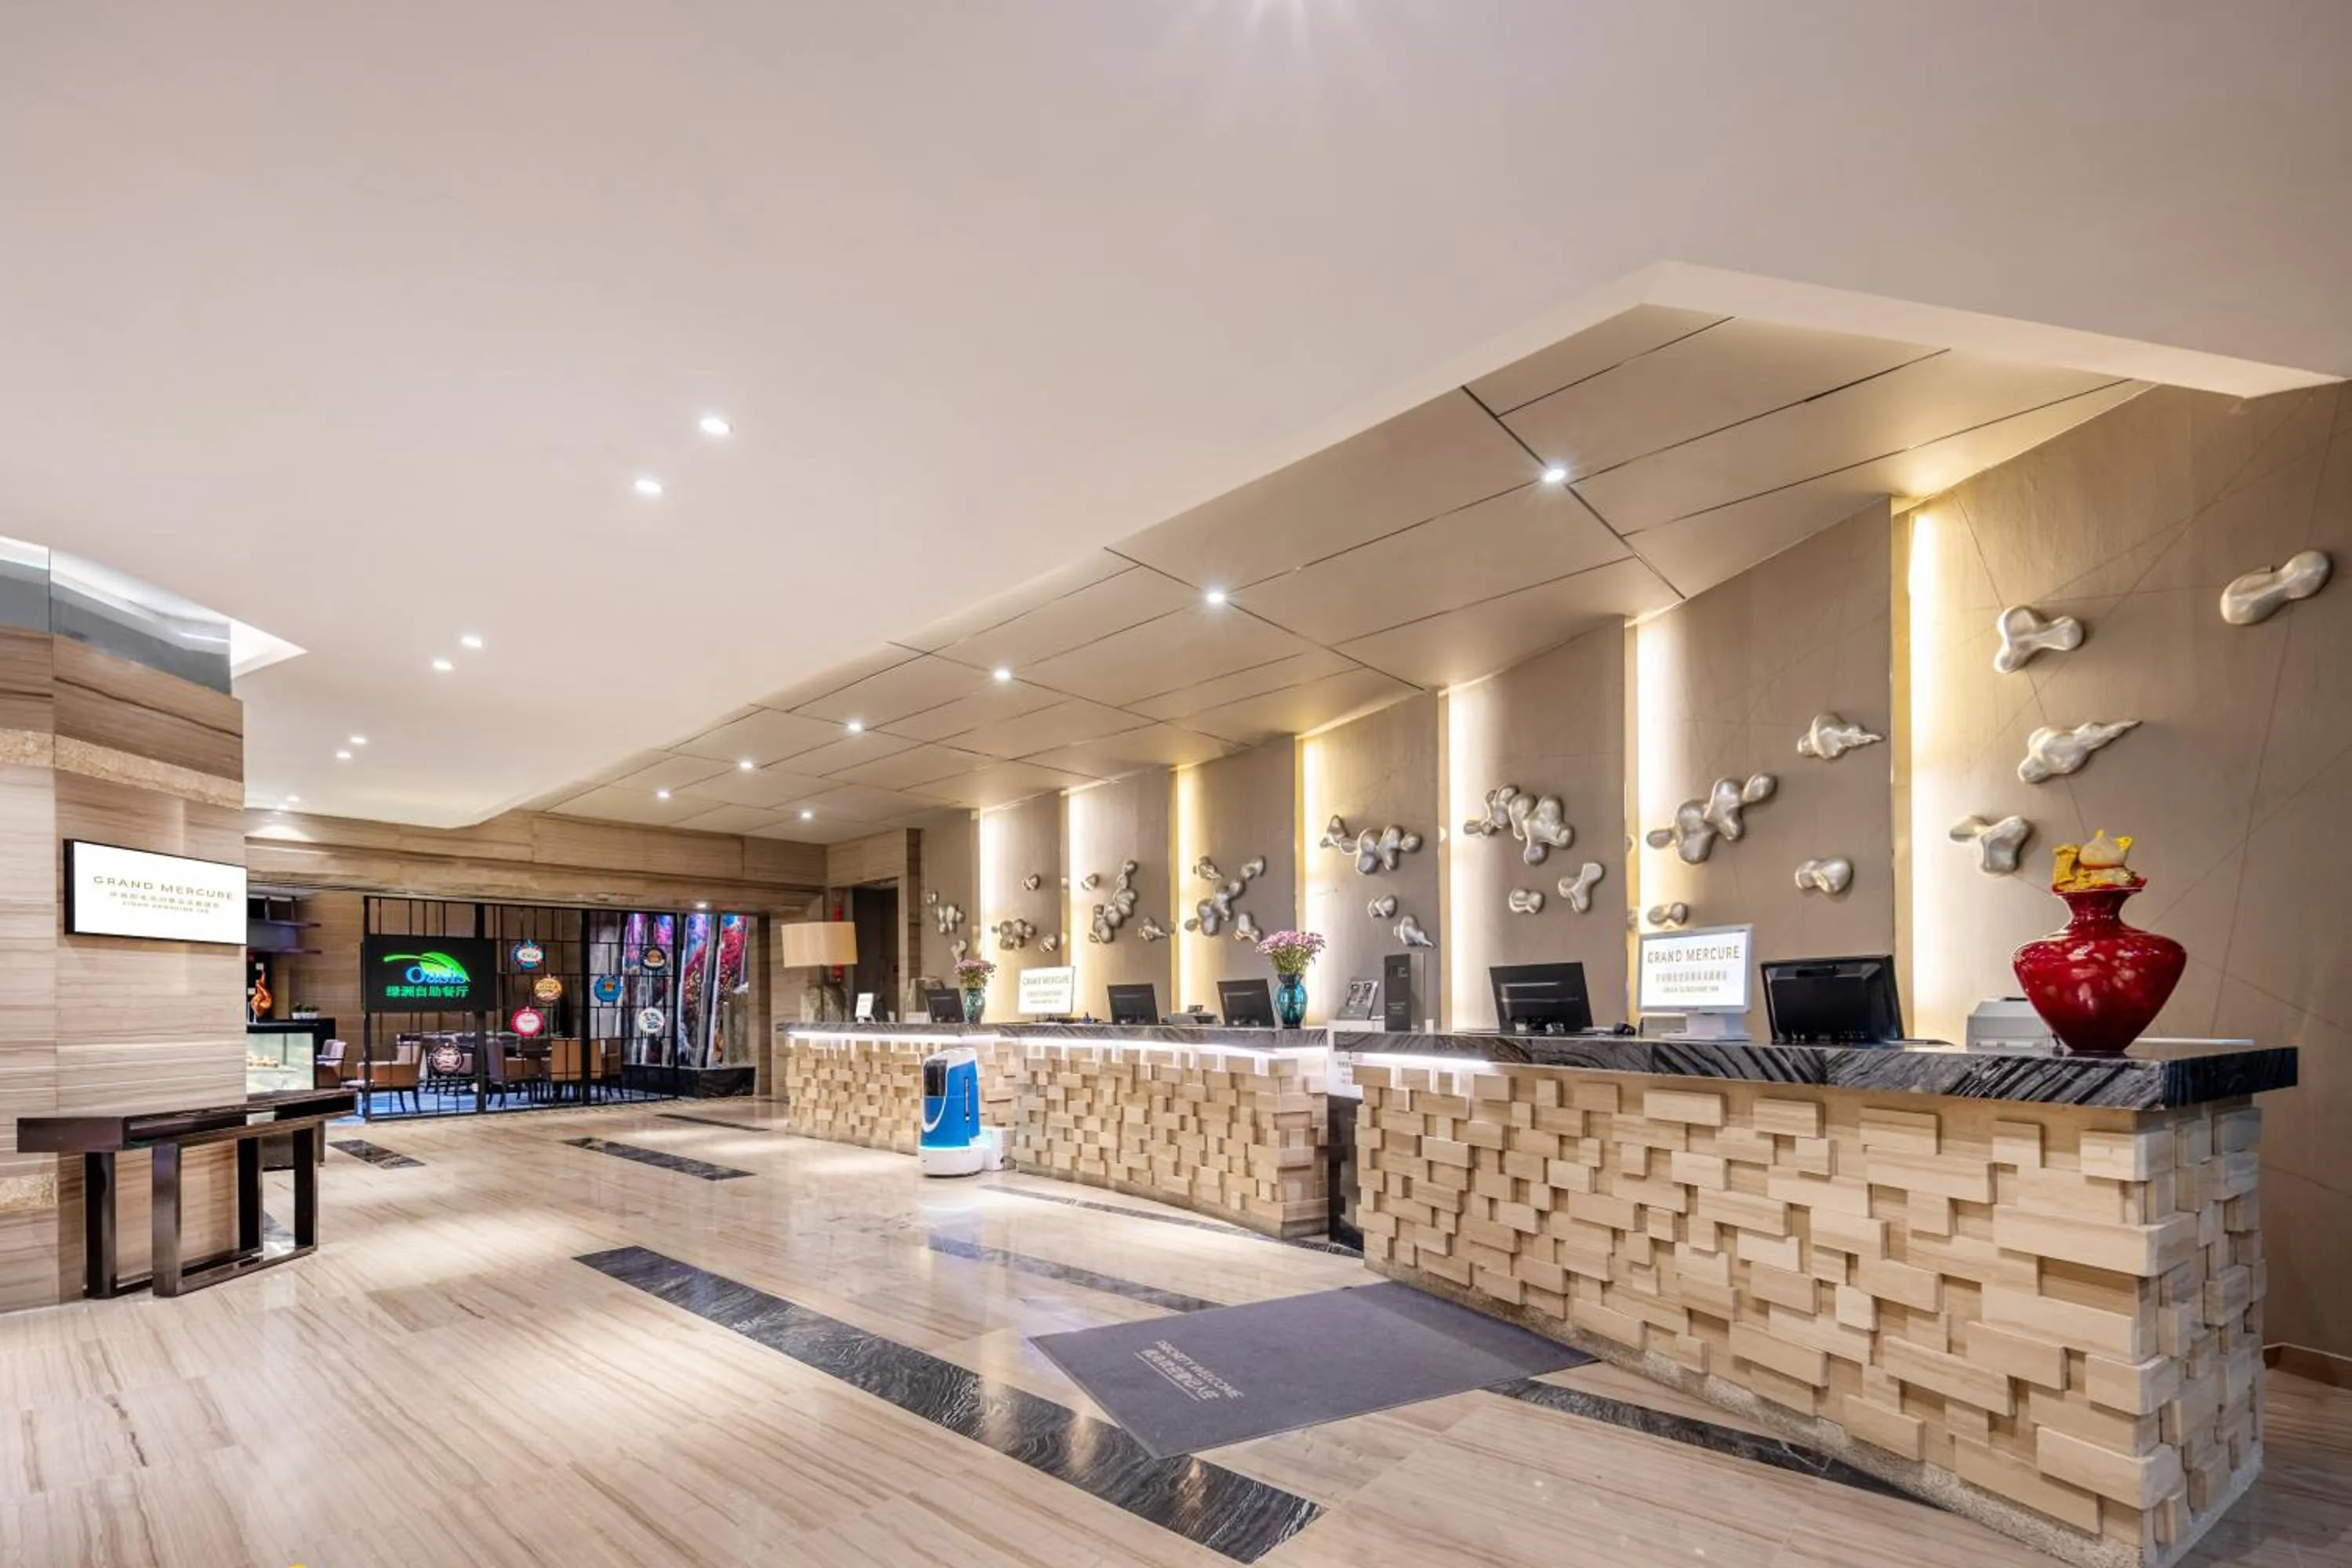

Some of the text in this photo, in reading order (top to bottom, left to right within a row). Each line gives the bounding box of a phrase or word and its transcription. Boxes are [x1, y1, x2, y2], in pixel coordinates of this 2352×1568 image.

[93, 876, 154, 890] GRAND
[161, 884, 234, 901] MERCURE
[1647, 946, 1741, 964] GRAND MERCURE
